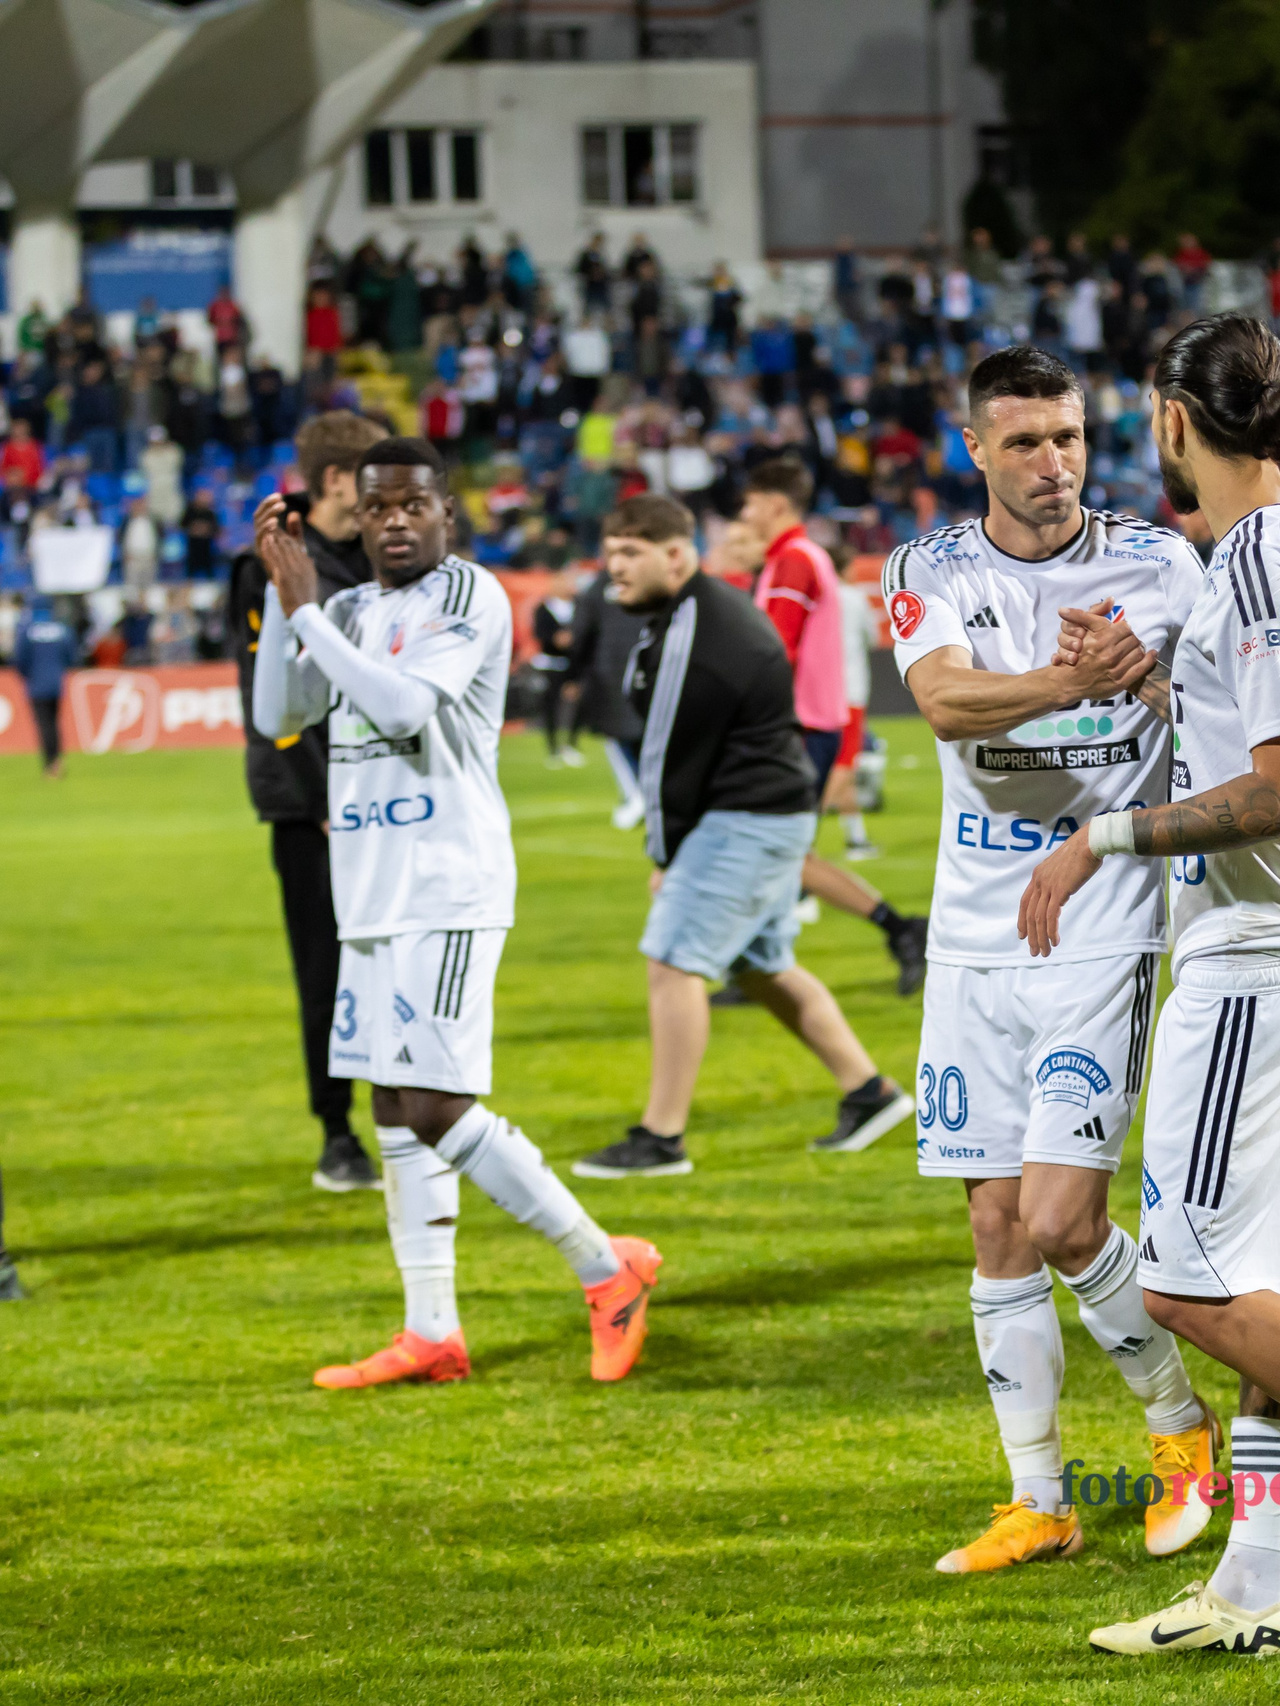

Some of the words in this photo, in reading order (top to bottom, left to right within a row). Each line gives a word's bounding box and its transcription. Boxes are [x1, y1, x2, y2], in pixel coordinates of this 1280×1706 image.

[983, 747, 1063, 769] ÎMPREUNĂ
[1066, 748, 1108, 767] SPRE
[1110, 744, 1132, 763] 0%
[331, 795, 434, 831] SACO
[957, 801, 1148, 851] ELSA
[1038, 1062, 1052, 1083] FIVE
[1051, 1055, 1108, 1090] CONTINENTS
[918, 1062, 968, 1132] 30
[938, 1145, 985, 1159] Vestra
